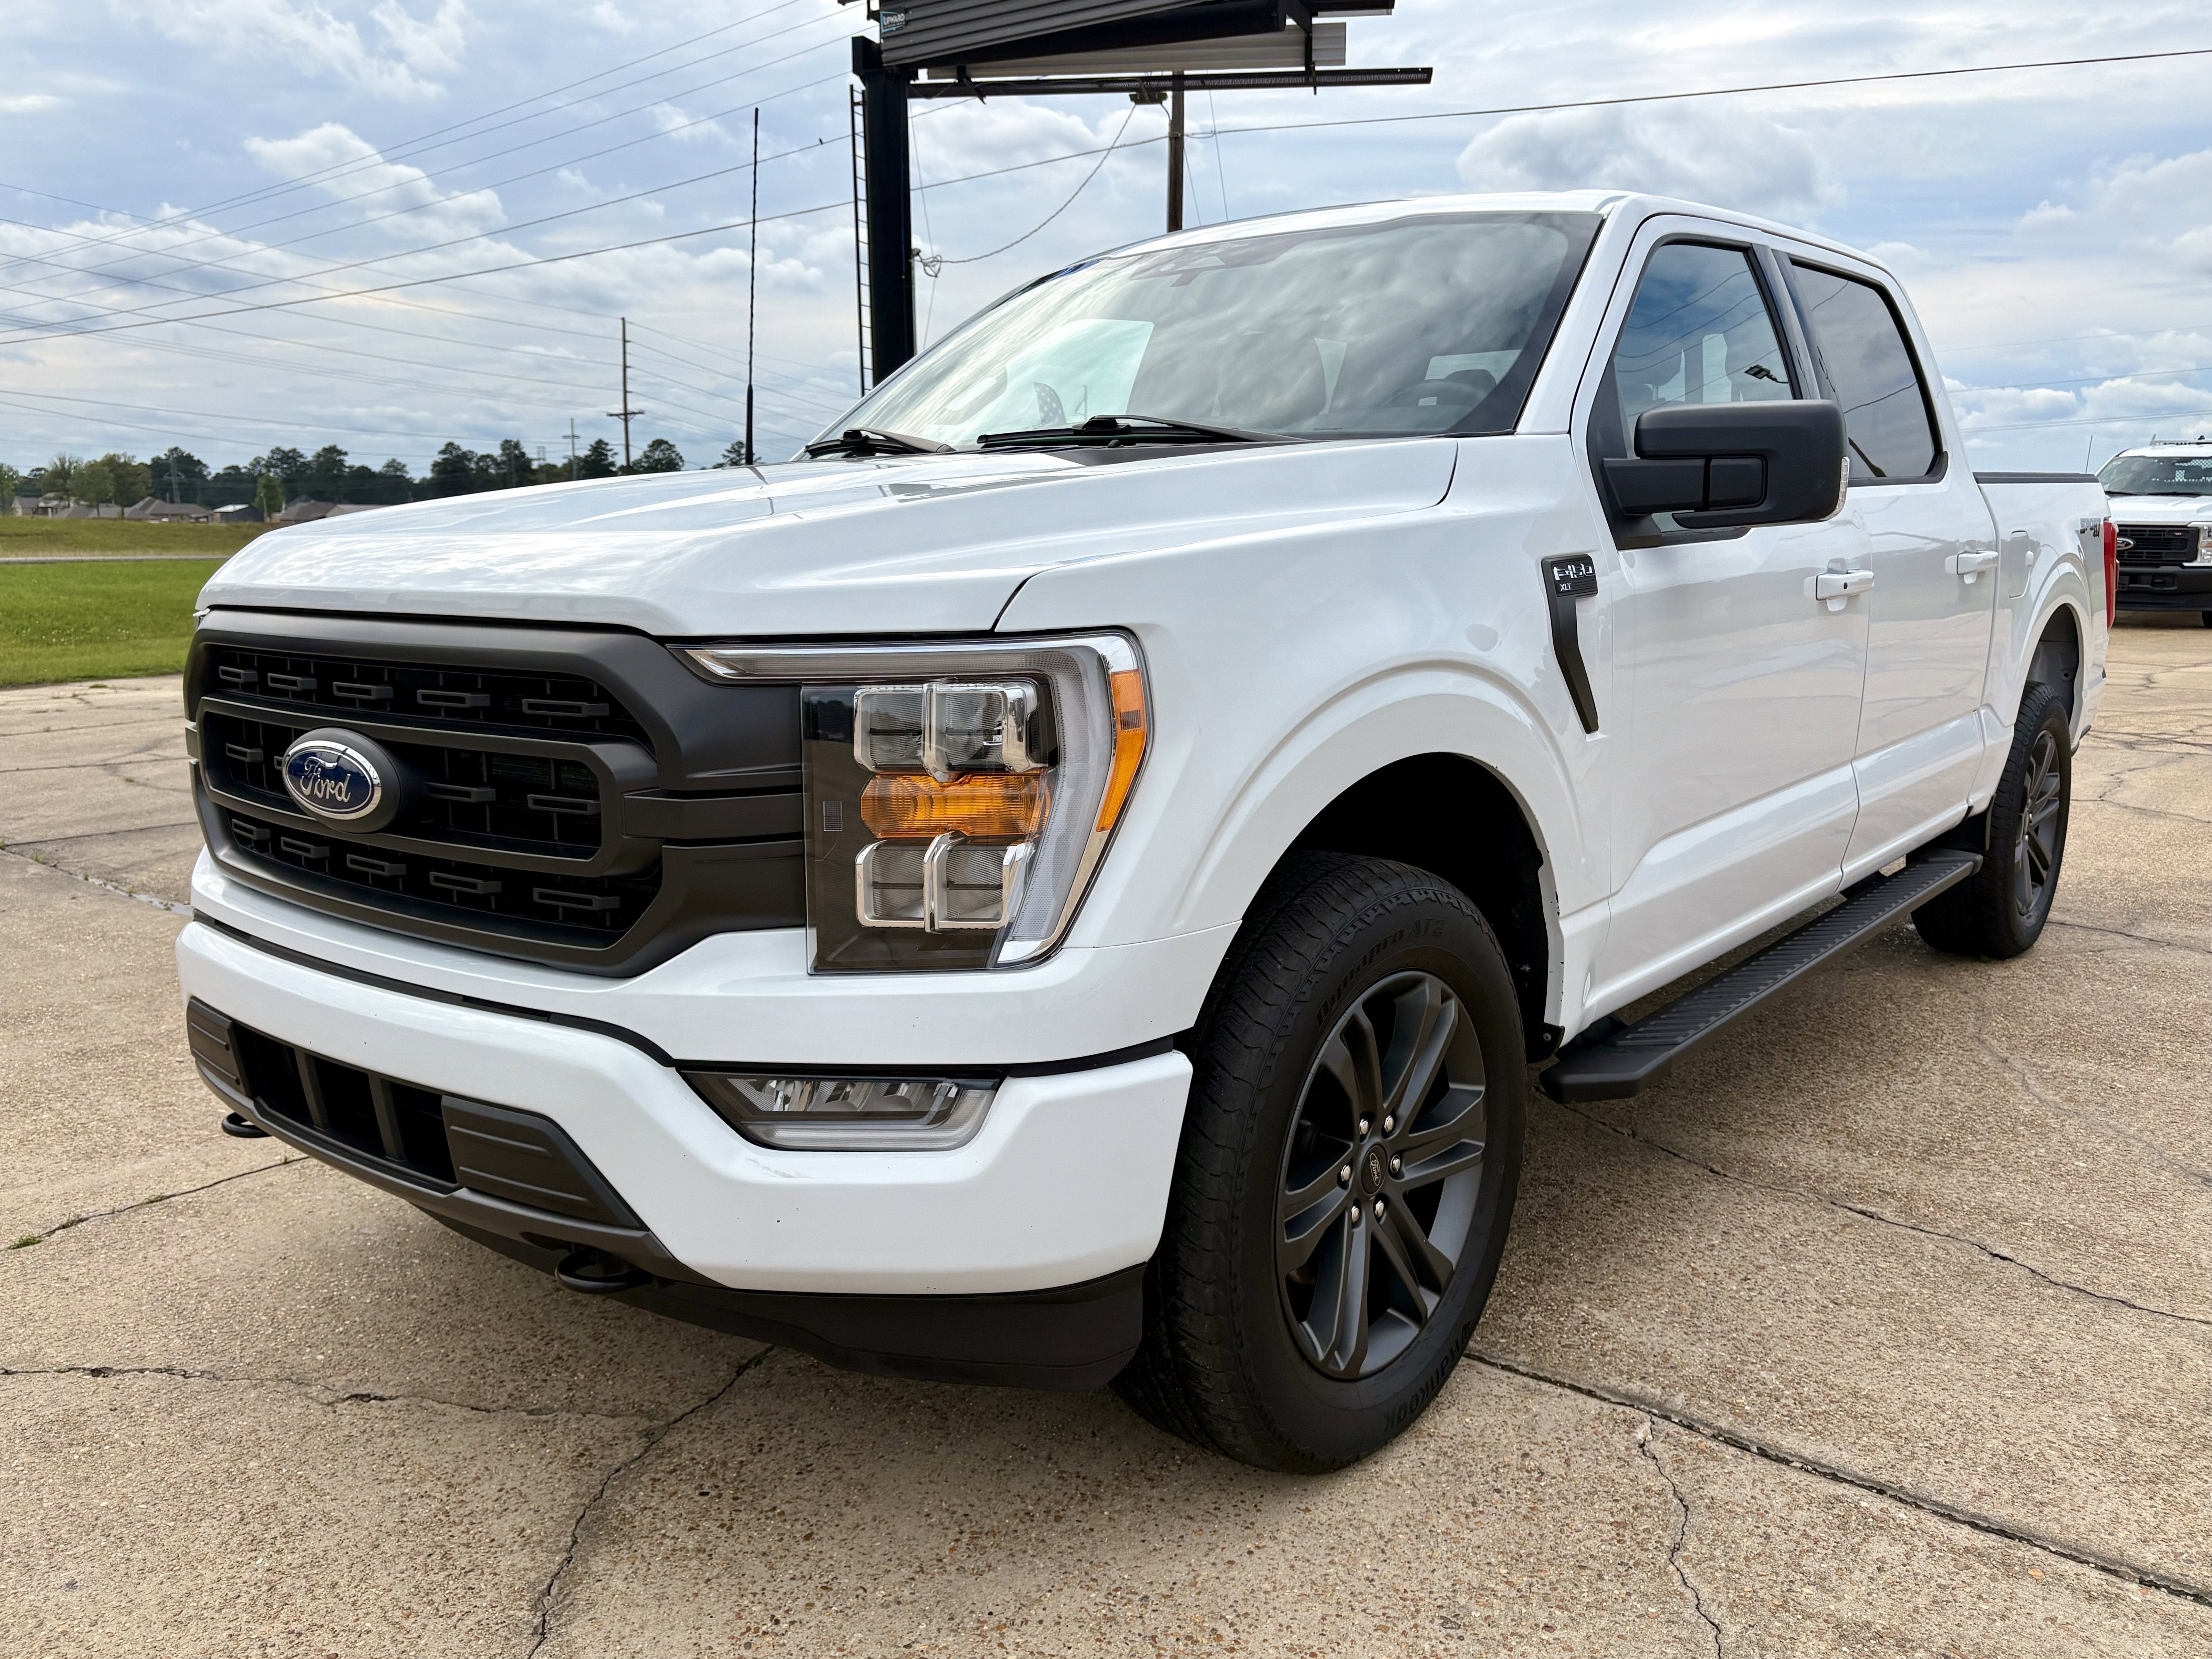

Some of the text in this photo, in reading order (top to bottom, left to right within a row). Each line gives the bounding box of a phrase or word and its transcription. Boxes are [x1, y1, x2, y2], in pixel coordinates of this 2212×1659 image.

[1560, 583, 1571, 591] XLT
[299, 756, 351, 803] Ford
[1316, 918, 1446, 1030] Dynapro AT2
[1371, 1159, 1379, 1181] Ford
